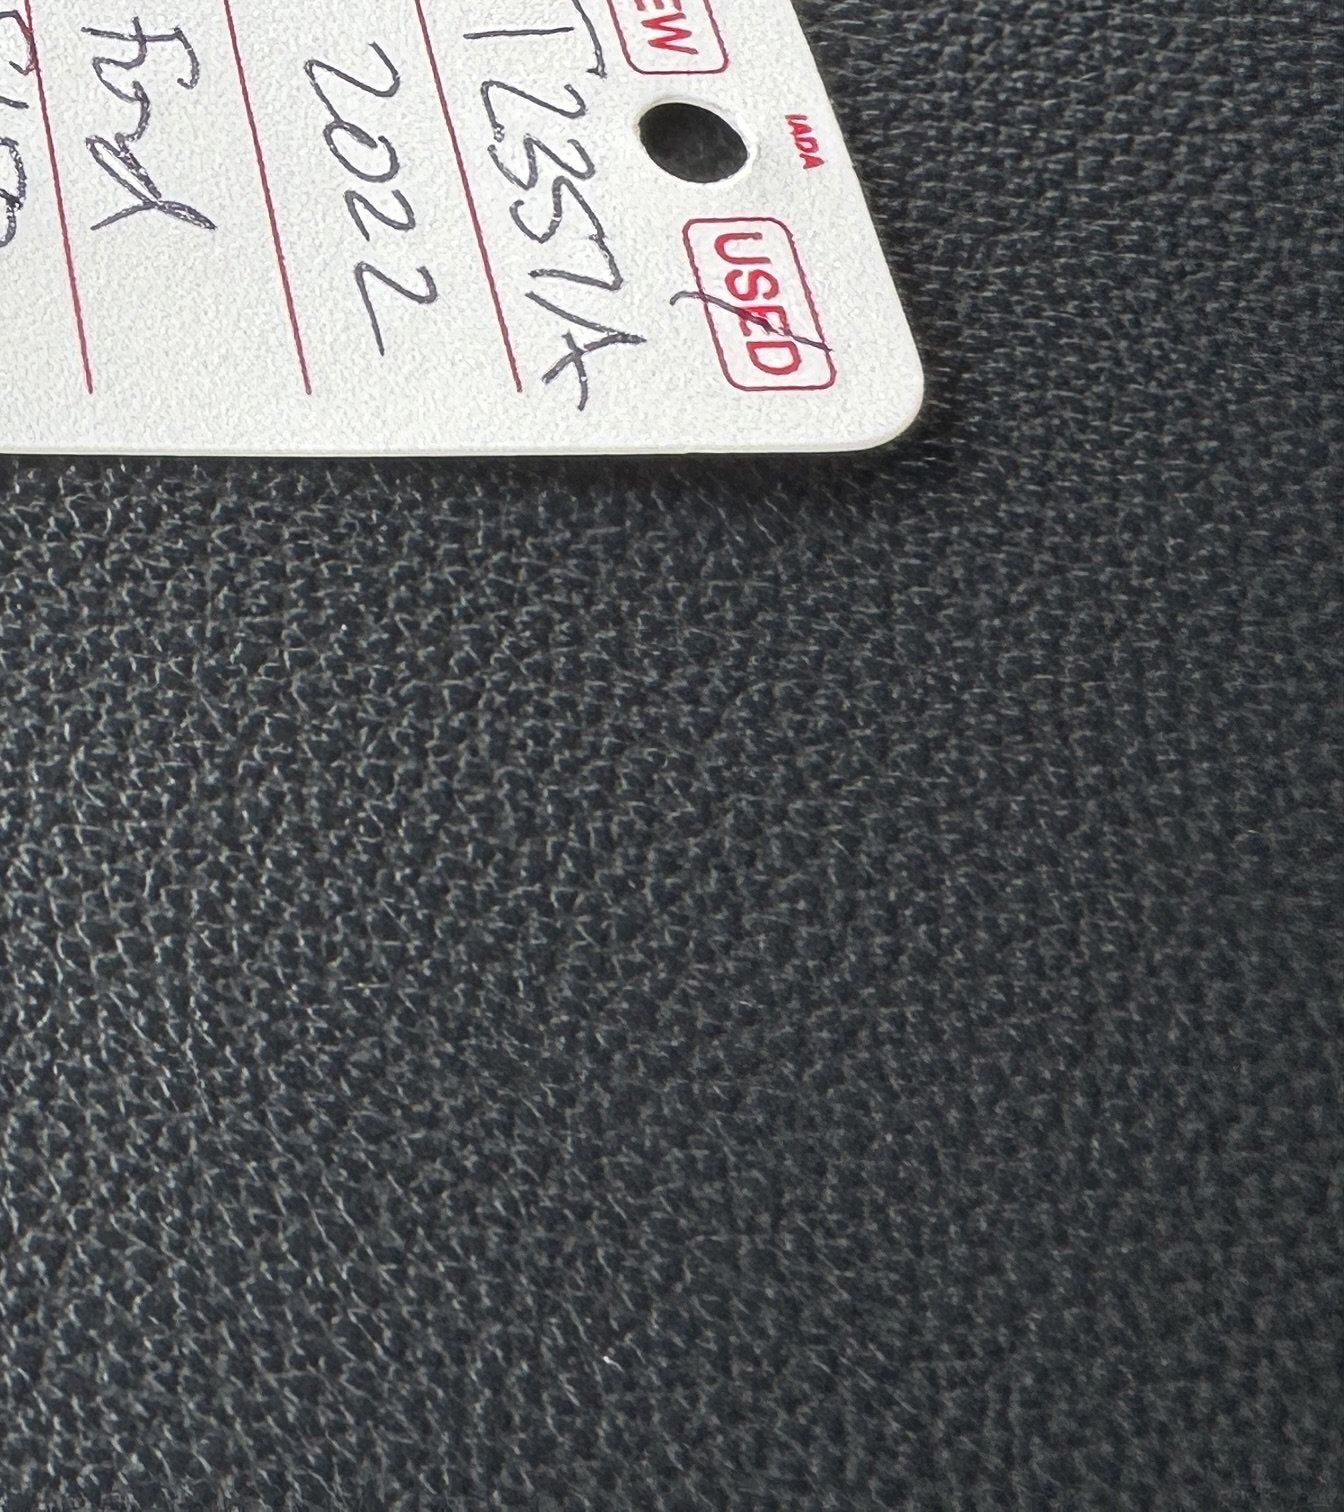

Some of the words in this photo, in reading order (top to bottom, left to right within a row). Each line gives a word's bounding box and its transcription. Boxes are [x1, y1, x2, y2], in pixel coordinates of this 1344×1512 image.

[80, 16, 218, 230] Ford
[304, 41, 440, 357] 2022
[784, 113, 826, 171] IADA
[712, 231, 803, 376] USED
